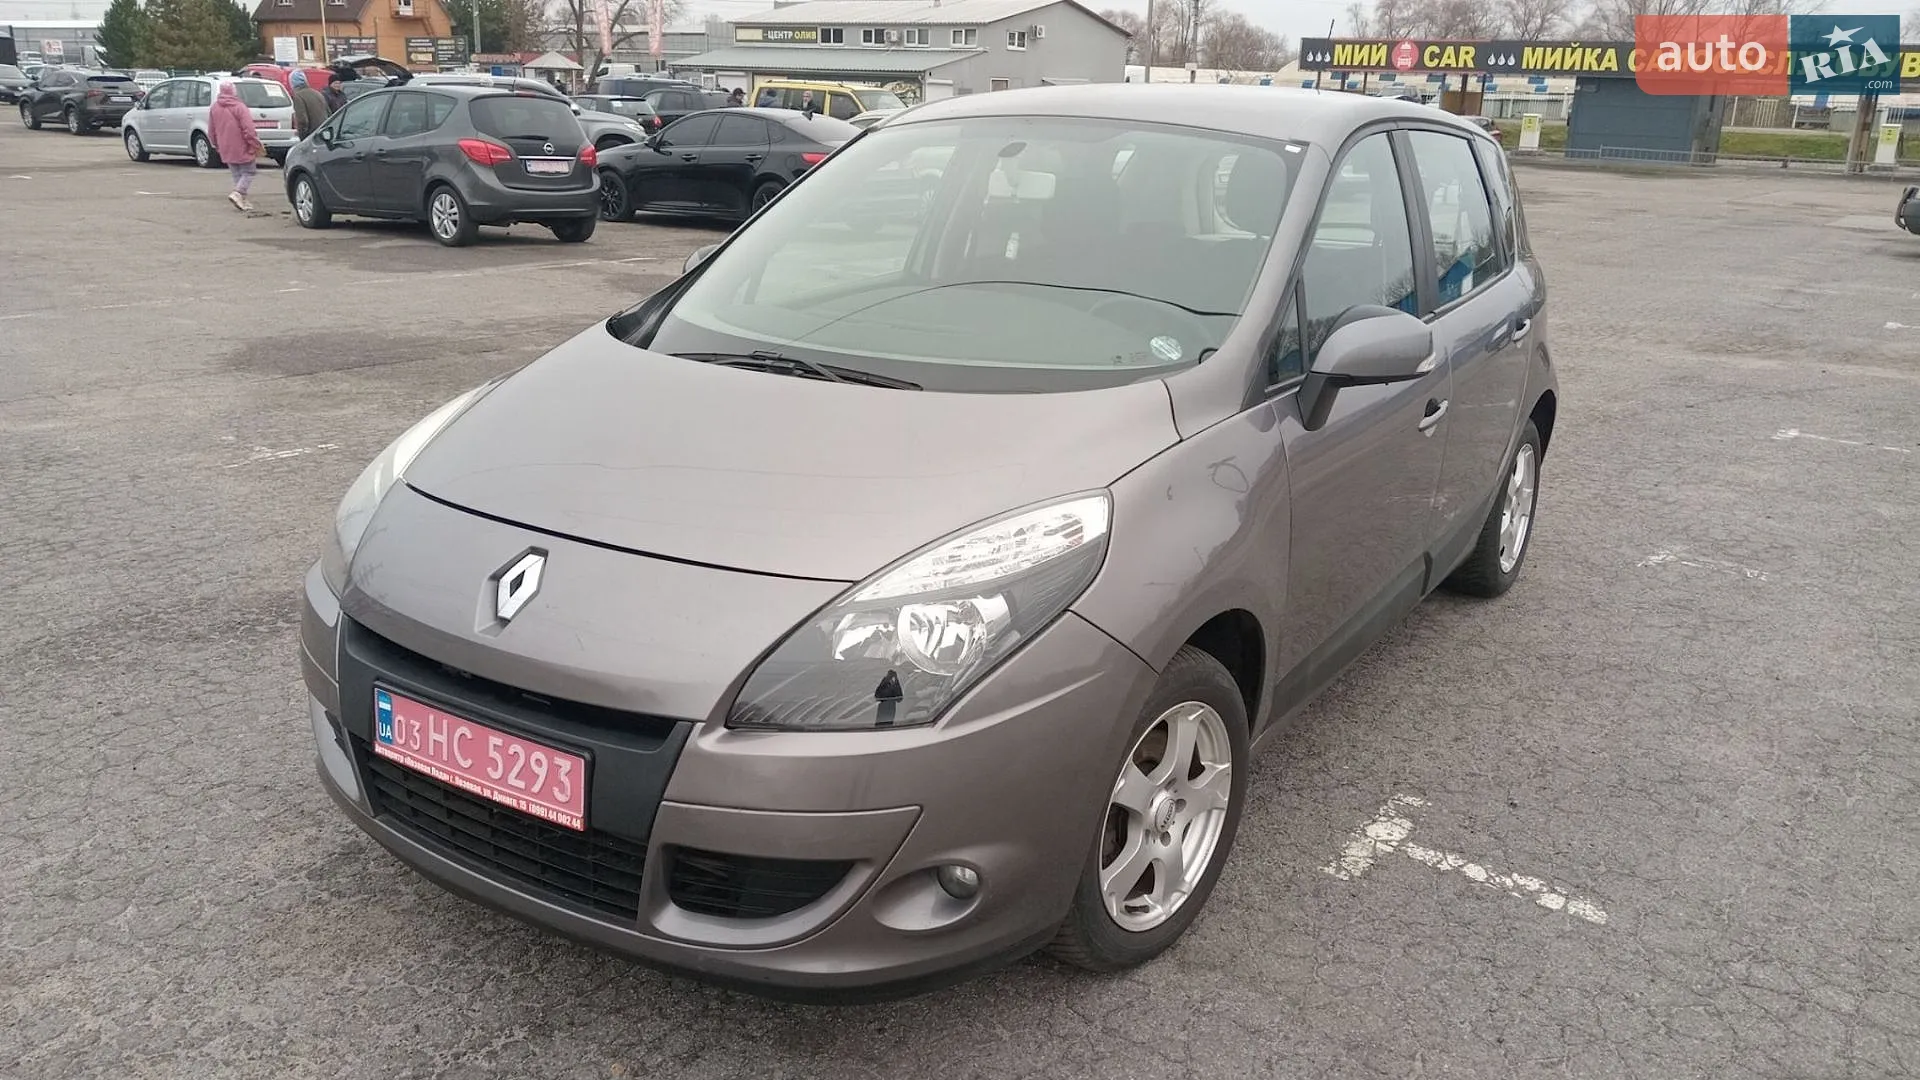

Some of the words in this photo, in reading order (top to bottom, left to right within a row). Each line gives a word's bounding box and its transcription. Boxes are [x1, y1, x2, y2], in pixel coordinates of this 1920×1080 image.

[1332, 42, 1388, 67] МИЙ
[1423, 44, 1477, 68] CAR
[1521, 42, 1619, 72] МИЙКА
[379, 722, 392, 739] UA
[394, 715, 421, 751] 03
[486, 736, 572, 803] 5293
